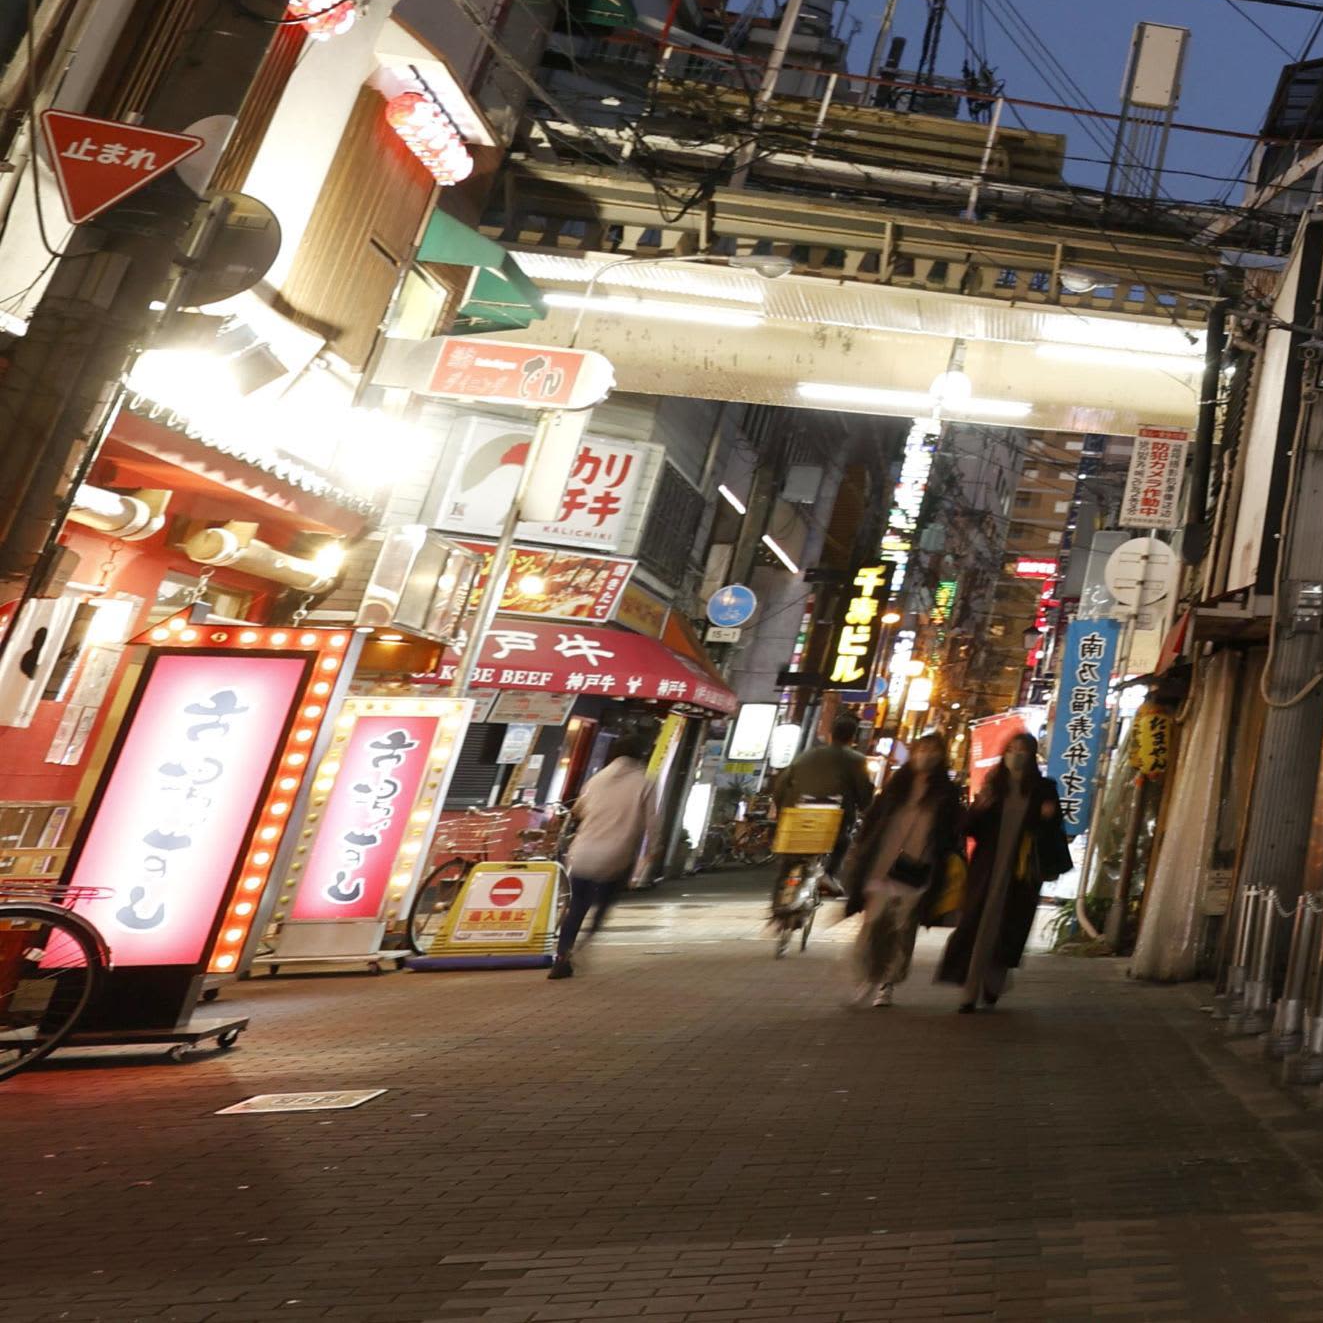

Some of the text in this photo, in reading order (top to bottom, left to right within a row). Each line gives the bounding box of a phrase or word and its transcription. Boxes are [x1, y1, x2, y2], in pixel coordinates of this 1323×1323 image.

[60, 137, 157, 171] 止まれ
[570, 445, 634, 489] カリ
[1140, 441, 1170, 517] 防犯カメラ作動中
[558, 488, 622, 528] チキ
[438, 664, 496, 683] KBE
[497, 669, 554, 687] BEEF
[564, 672, 616, 692] 神戸牛
[656, 678, 688, 696] 神戸牛
